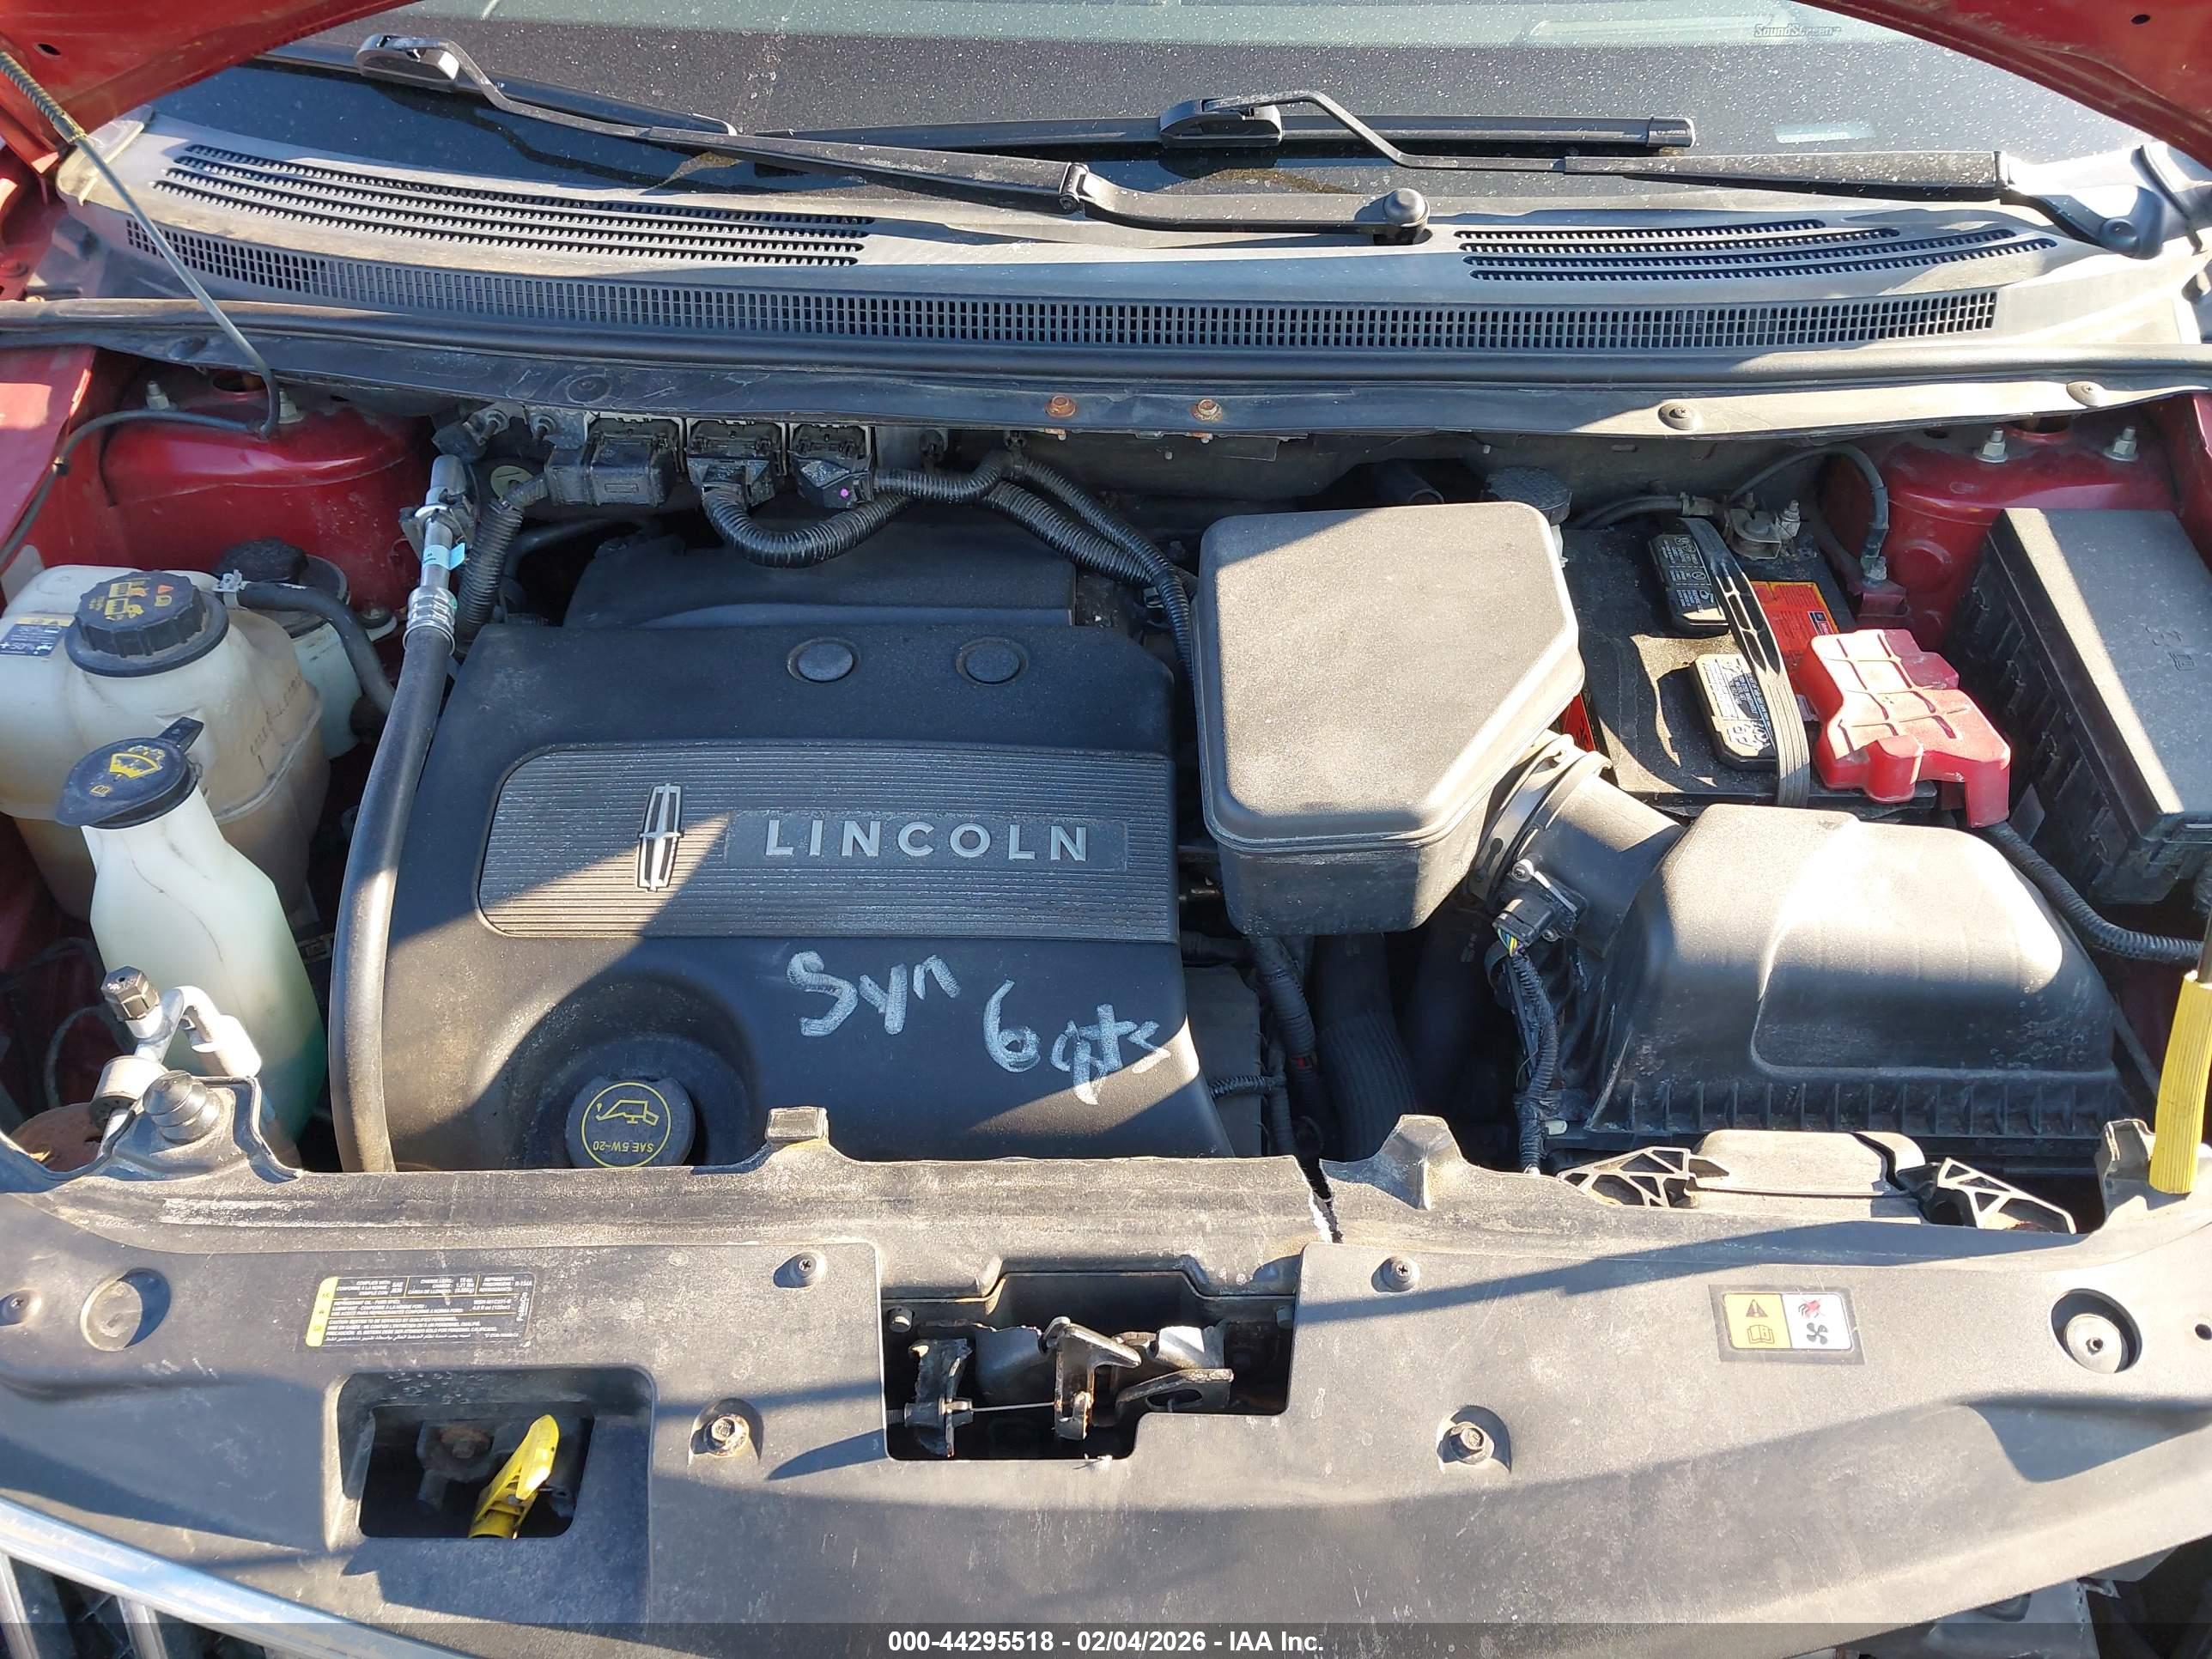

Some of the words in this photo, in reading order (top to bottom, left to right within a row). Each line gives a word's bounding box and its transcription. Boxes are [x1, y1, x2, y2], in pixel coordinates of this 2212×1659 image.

[765, 818, 1088, 862] LINCOLN
[592, 1140, 629, 1152] 5W-20
[632, 1140, 654, 1153] SAE
